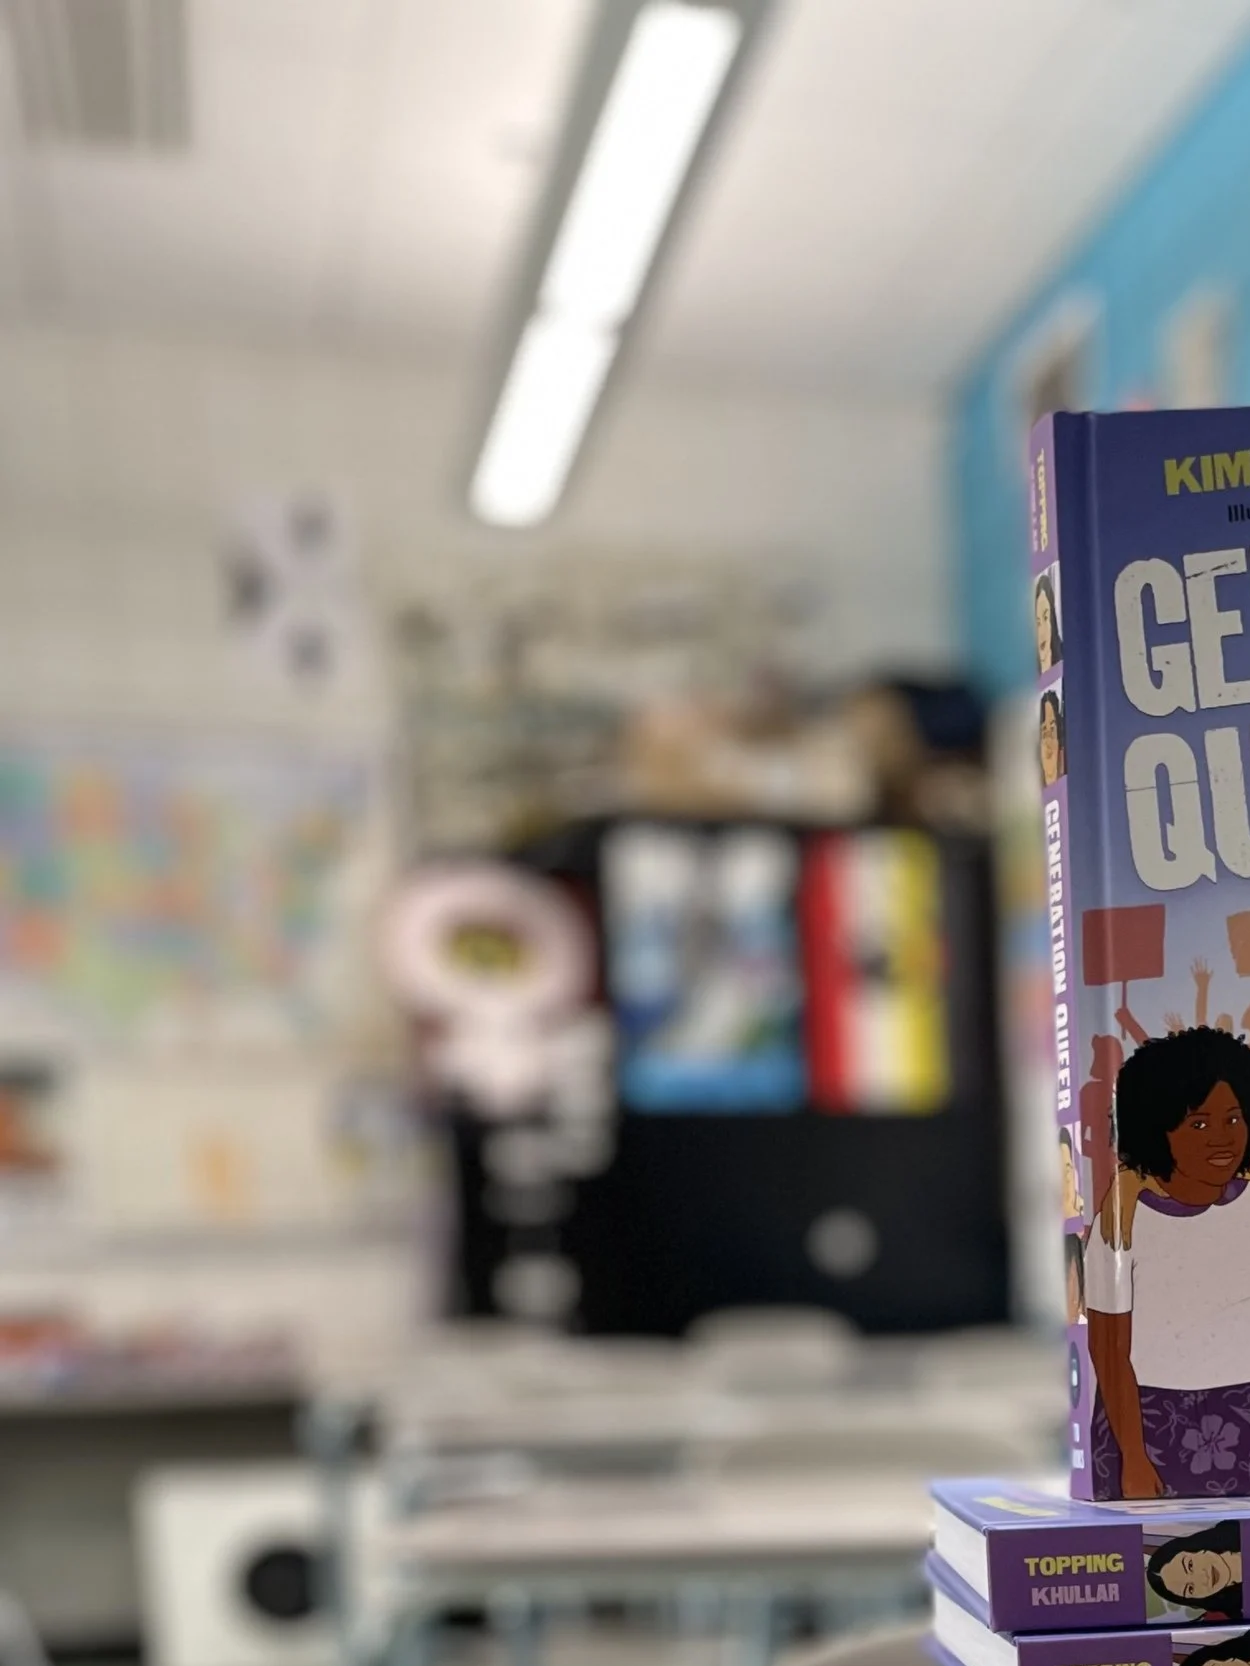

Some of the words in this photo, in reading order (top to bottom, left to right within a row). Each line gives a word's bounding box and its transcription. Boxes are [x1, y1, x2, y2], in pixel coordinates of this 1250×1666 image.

[1044, 799, 1067, 996] GENERATION
[1055, 1002, 1072, 1111] QUEER
[1024, 1553, 1124, 1577] TOPPING
[1031, 1583, 1120, 1607] KHULLAR
